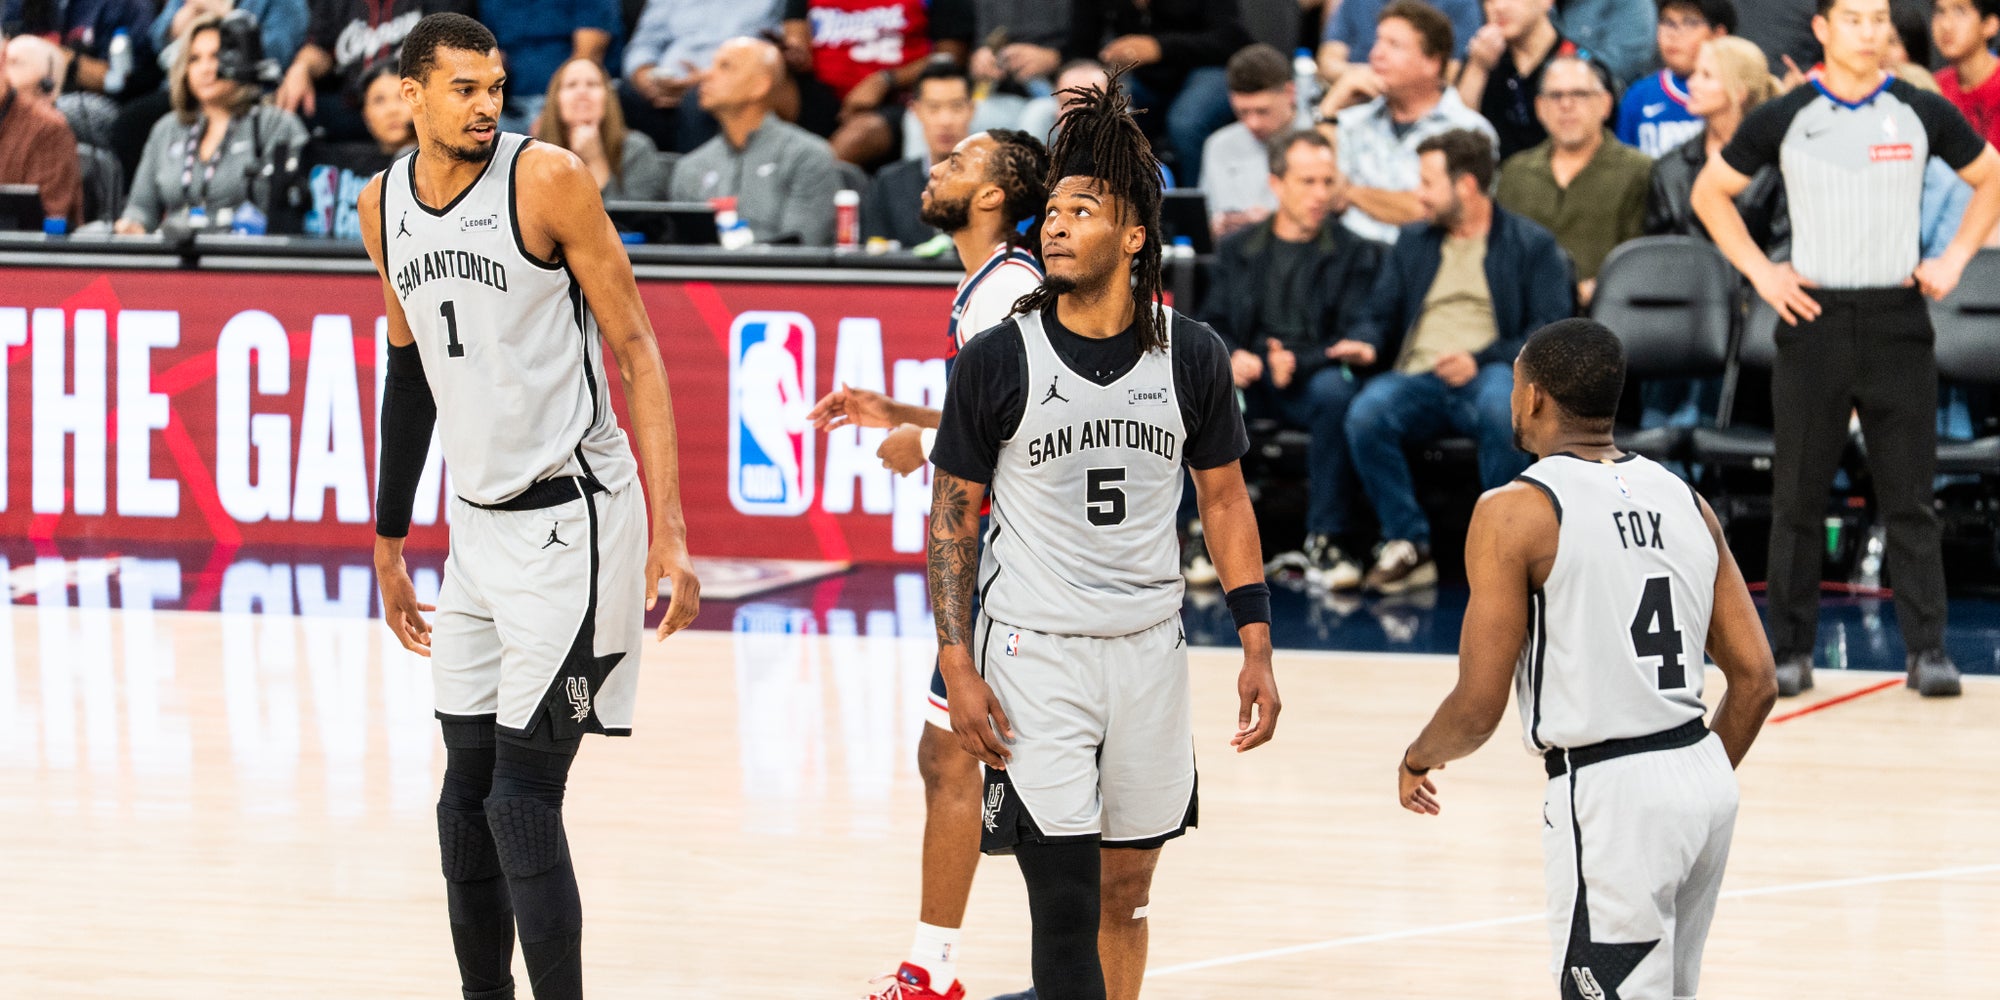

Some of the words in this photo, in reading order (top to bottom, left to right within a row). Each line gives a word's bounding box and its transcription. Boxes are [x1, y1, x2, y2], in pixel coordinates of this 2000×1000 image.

[464, 218, 492, 228] LEDGER
[396, 257, 422, 302] SAN
[424, 249, 508, 293] ANTONIO
[439, 299, 465, 358] 1
[1133, 392, 1163, 401] LEDGER
[1028, 425, 1072, 467] SAN
[1079, 418, 1176, 462] ANTONIO
[1086, 467, 1127, 527] 5
[1612, 510, 1664, 550] FOX
[1629, 575, 1687, 692] 4
